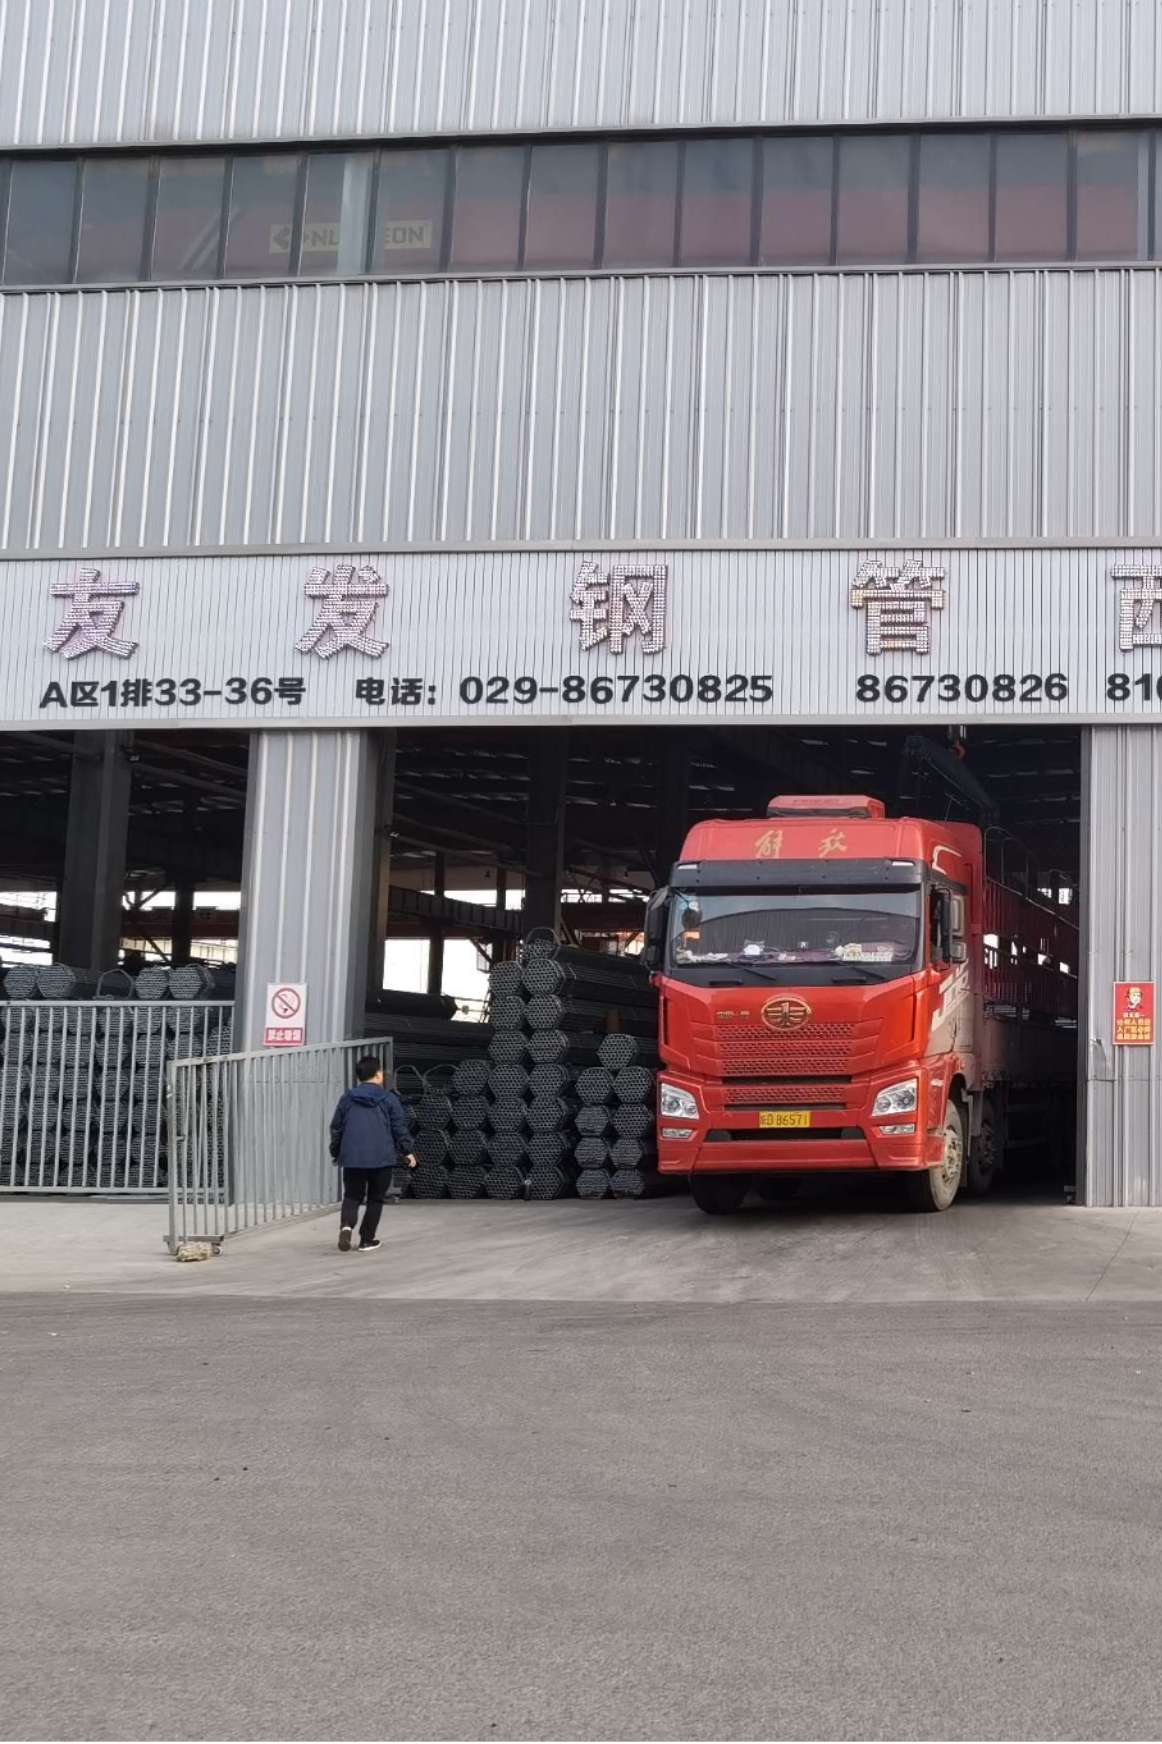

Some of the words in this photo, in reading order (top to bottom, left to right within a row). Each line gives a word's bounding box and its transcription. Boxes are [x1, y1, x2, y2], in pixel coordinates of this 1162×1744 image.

[39, 678, 307, 709] A区1排33-36号
[856, 673, 1069, 703] 86730826
